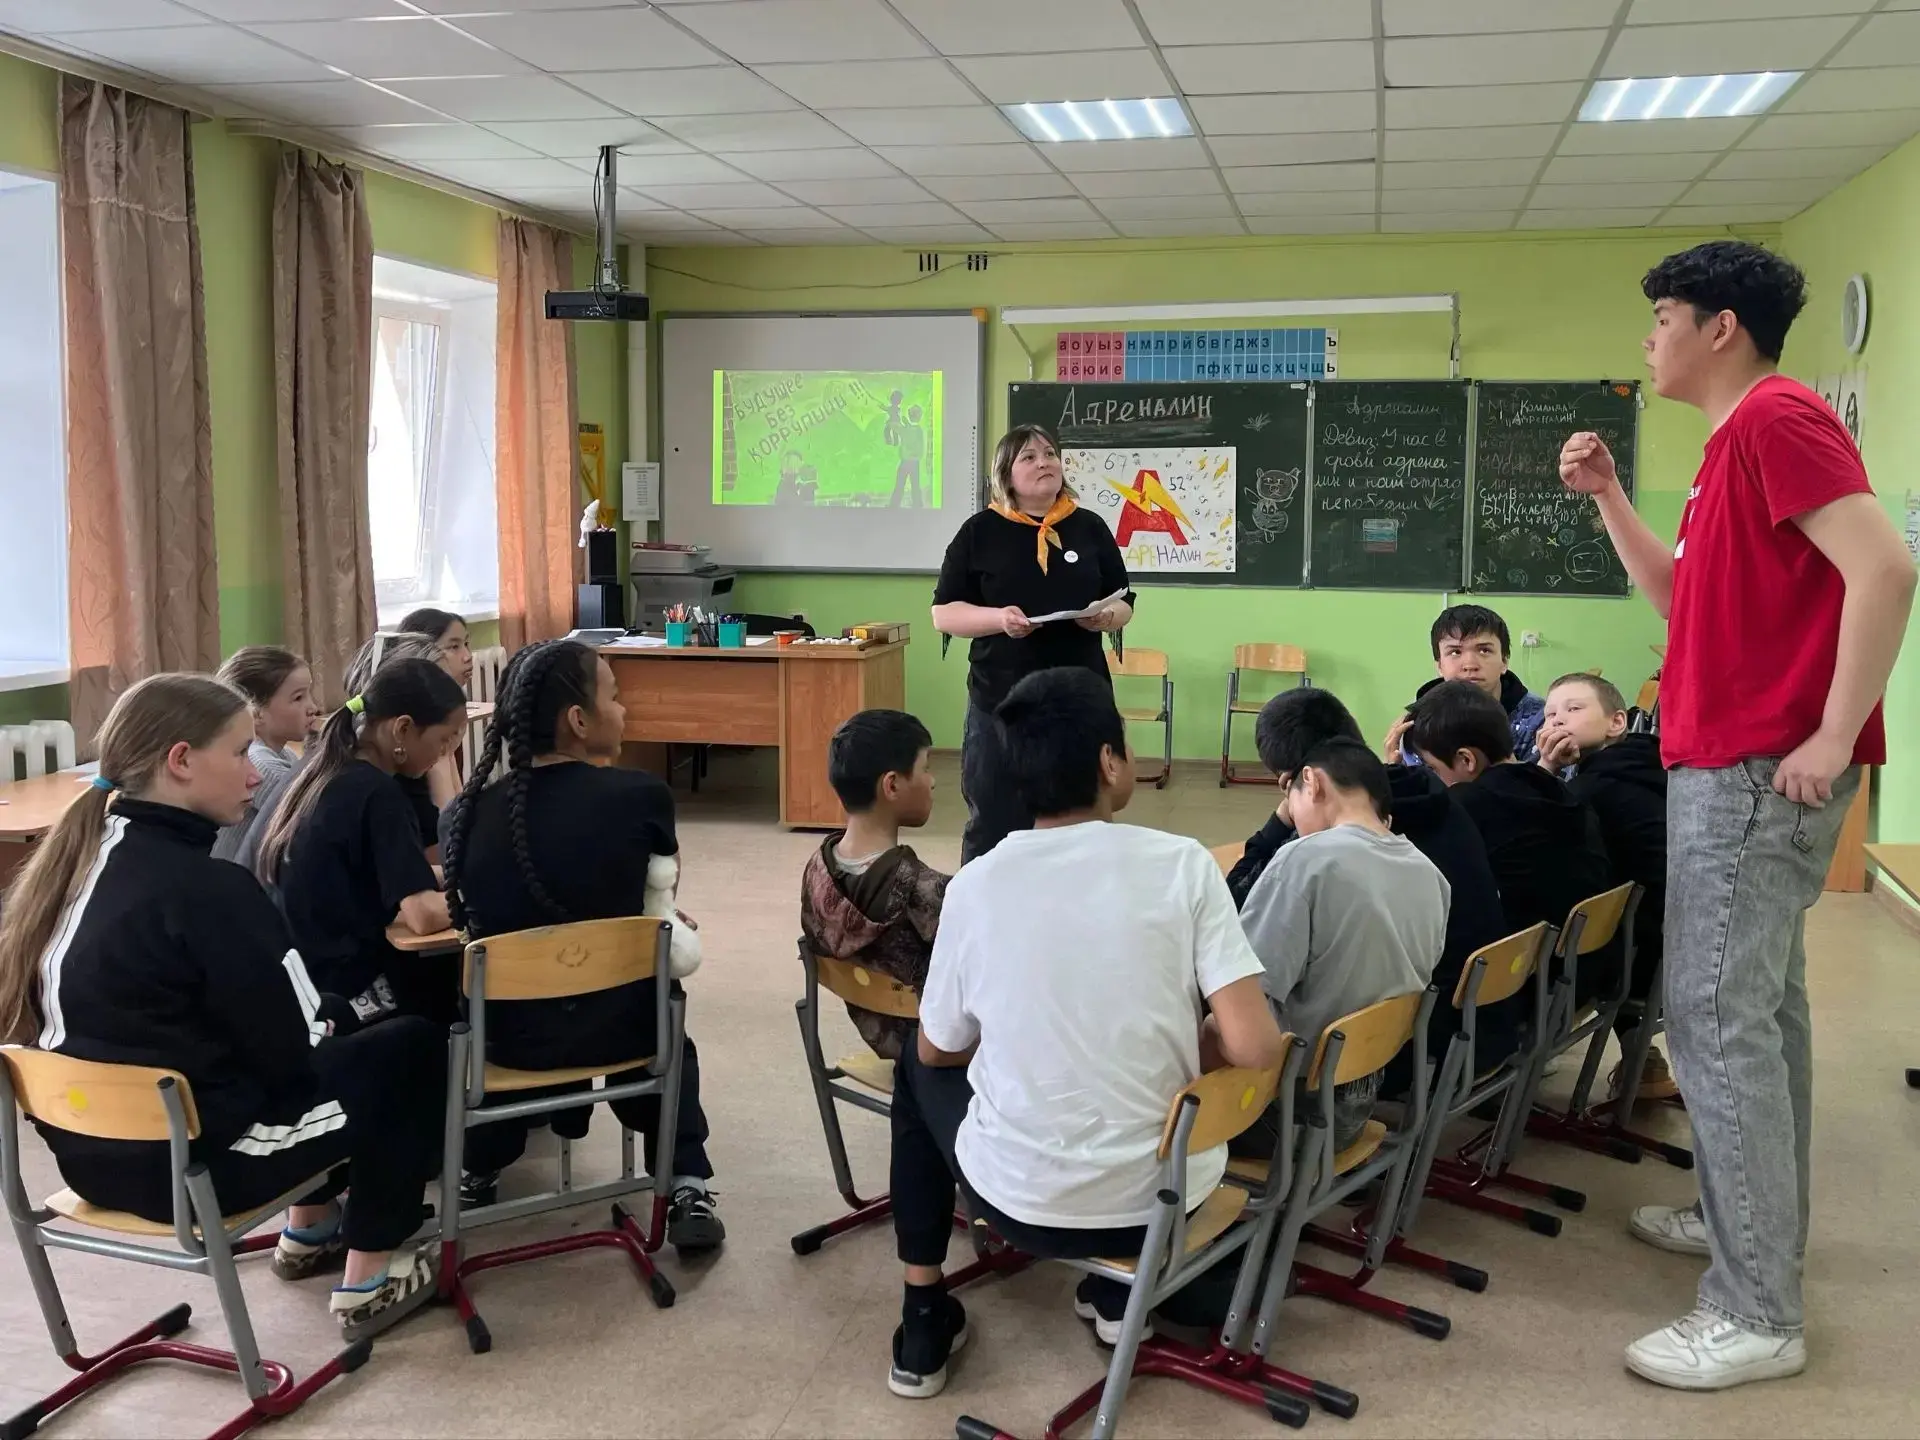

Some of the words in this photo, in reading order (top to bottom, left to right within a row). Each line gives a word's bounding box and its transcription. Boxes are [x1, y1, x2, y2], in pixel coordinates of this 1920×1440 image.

[1058, 386, 1213, 425] Адреналин
[1169, 477, 1185, 491] 52
[1097, 489, 1121, 507] 69
